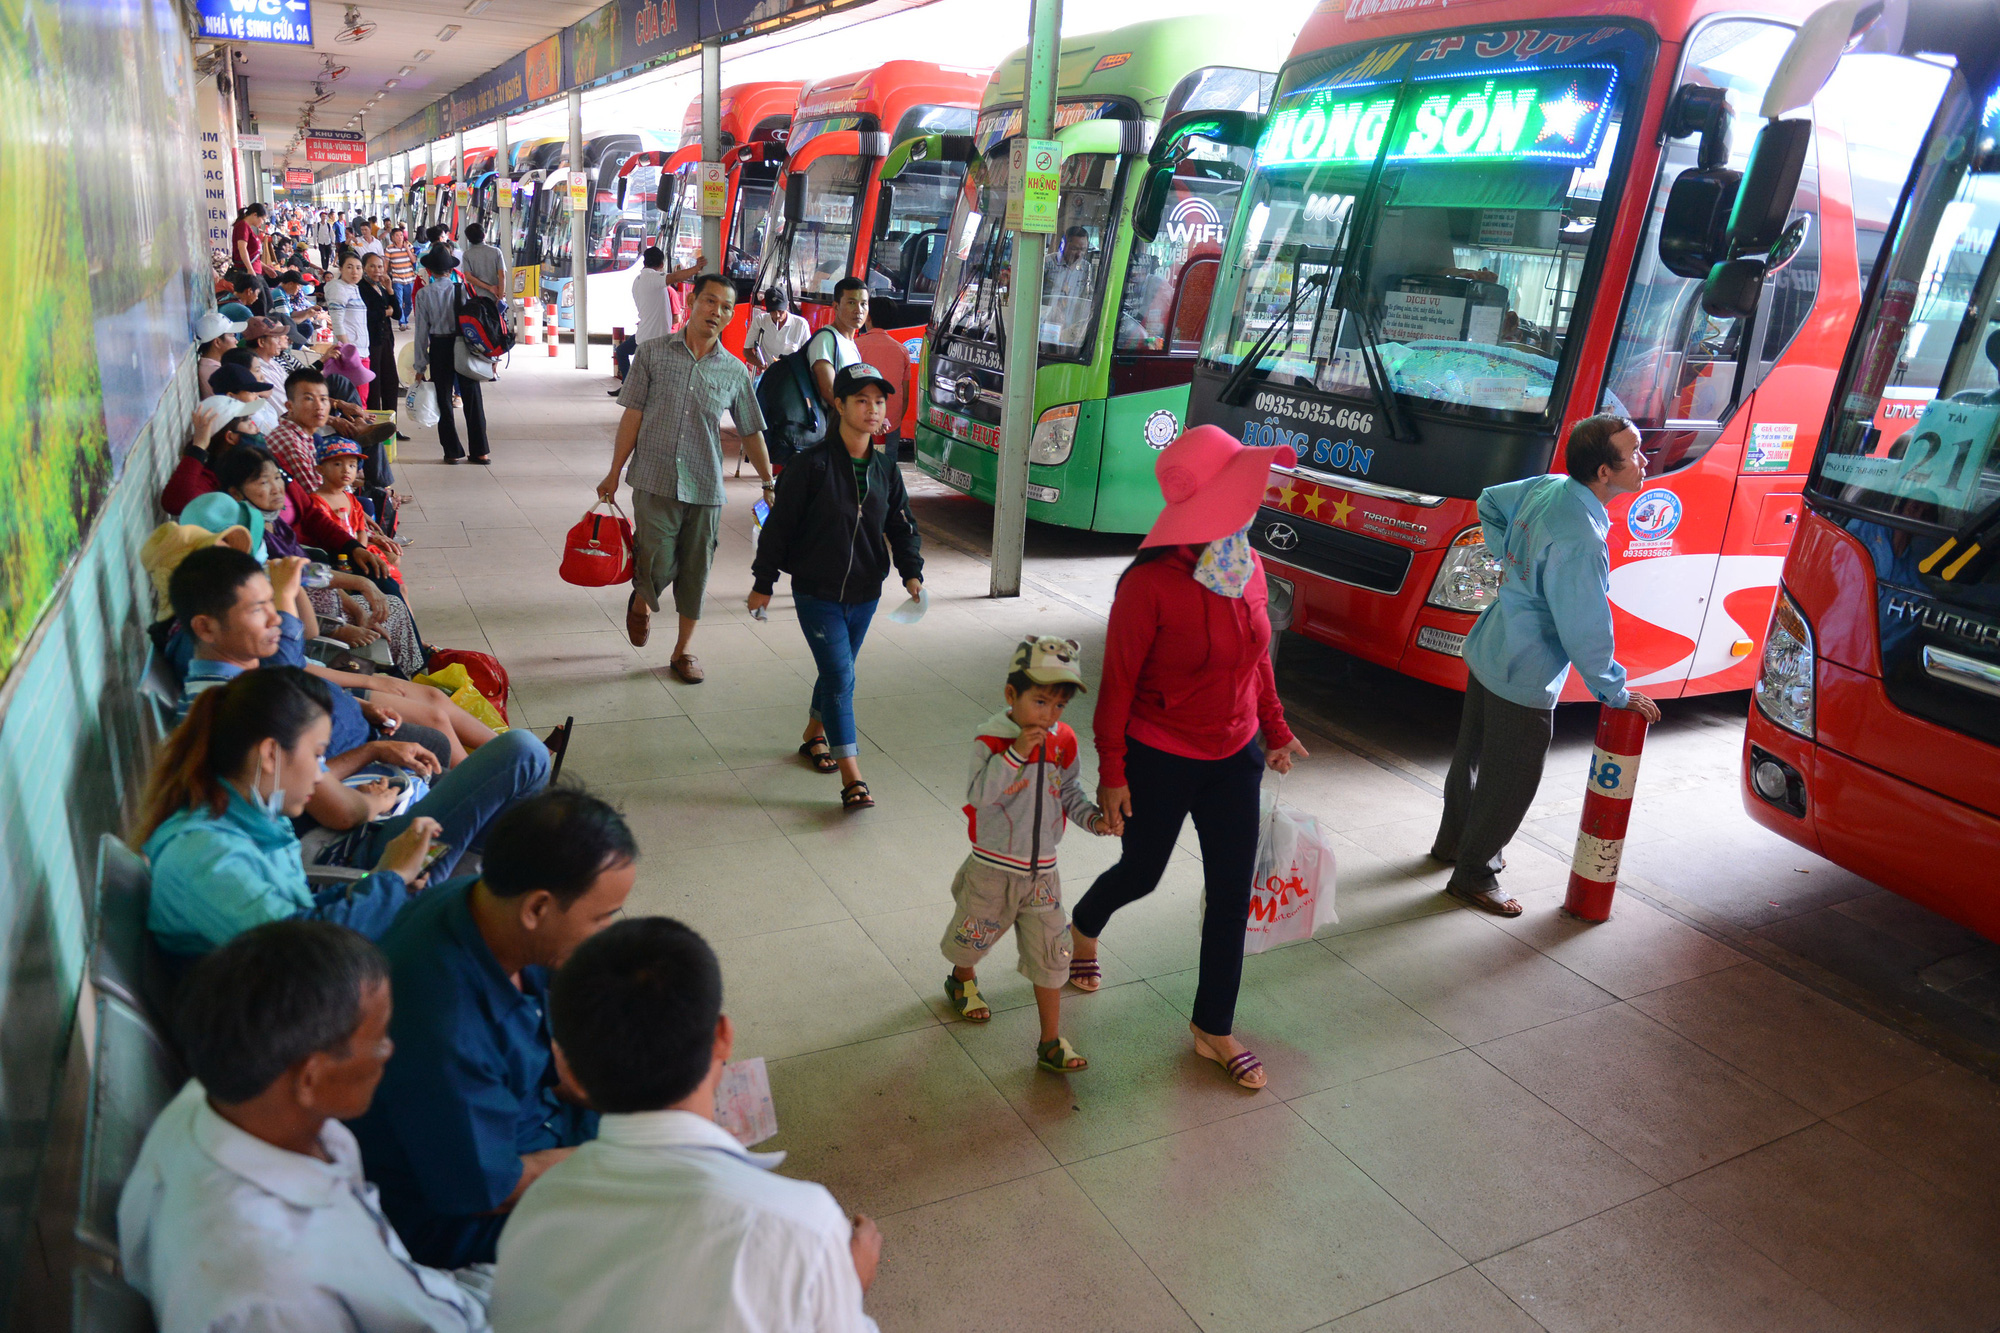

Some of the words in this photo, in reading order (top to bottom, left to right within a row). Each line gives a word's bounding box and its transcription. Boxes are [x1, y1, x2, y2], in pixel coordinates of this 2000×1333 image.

[205, 12, 229, 35] NHÀ
[229, 14, 245, 38] VỆ
[246, 19, 272, 39] SINH
[273, 16, 295, 41] CỬA
[296, 24, 310, 42] 3A
[661, 0, 679, 36] 3A
[1404, 80, 1539, 156] SƠN
[313, 150, 326, 160] TÂY
[327, 151, 352, 161] NGUYÊN
[353, 142, 364, 152] TÀU
[1028, 173, 1057, 191] KHÔNG
[1166, 222, 1224, 243] WiFi
[1406, 296, 1427, 306] DỊCH
[1429, 298, 1441, 307] VỤ
[1255, 392, 1373, 434] 0935.935.666
[1948, 411, 1968, 424] TÀI
[1242, 416, 1309, 458] HỒNG
[1313, 438, 1375, 475] SƠN
[1901, 431, 1974, 492] 21
[1363, 510, 1428, 535] TRACOMECO
[1622, 549, 1673, 558] 0935935666
[1588, 753, 1622, 789] 48
